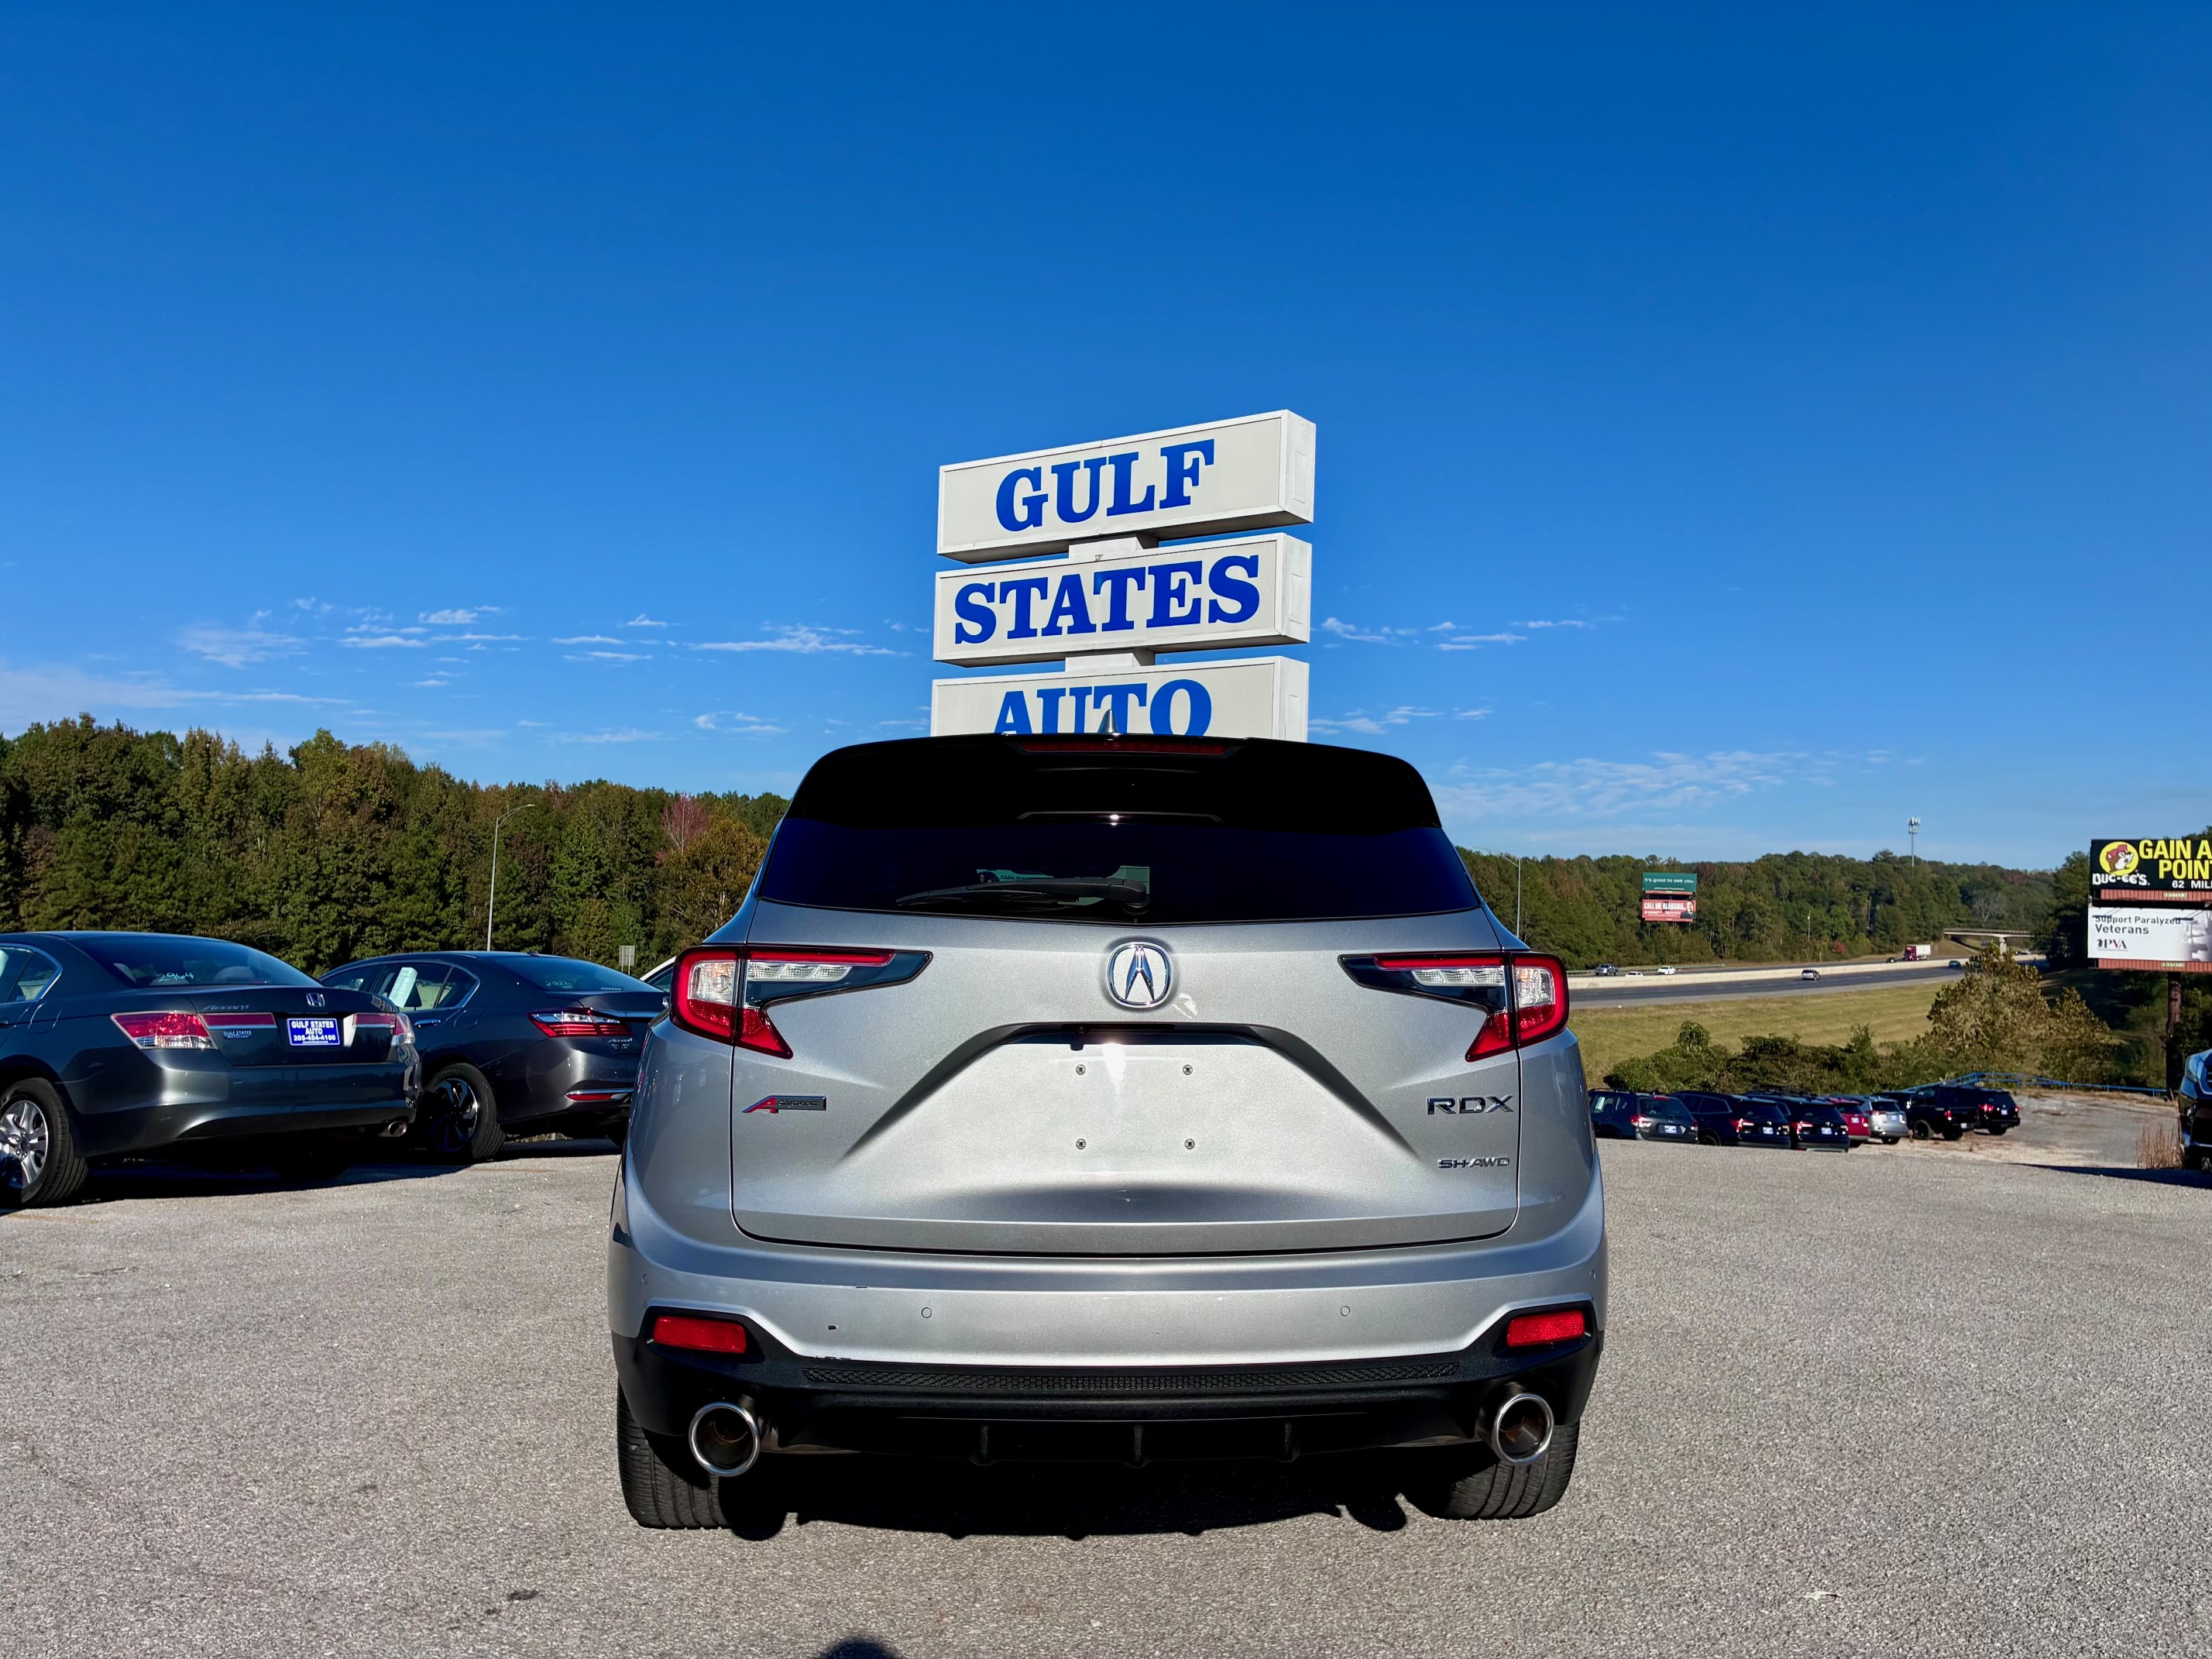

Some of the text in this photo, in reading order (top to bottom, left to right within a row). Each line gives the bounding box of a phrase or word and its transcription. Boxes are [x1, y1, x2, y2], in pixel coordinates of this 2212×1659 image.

[995, 438, 1214, 532] GULF
[954, 555, 1260, 645] STATES
[994, 678, 1213, 737] AUTO
[2138, 839, 2191, 860] GAIN
[2171, 880, 2212, 889] 62 MIL
[2094, 915, 2132, 925] Support
[2094, 923, 2149, 935] Veterans
[157, 972, 194, 982] 2964
[291, 1020, 335, 1029] GULF STATES
[1427, 1094, 1514, 1115] RDX
